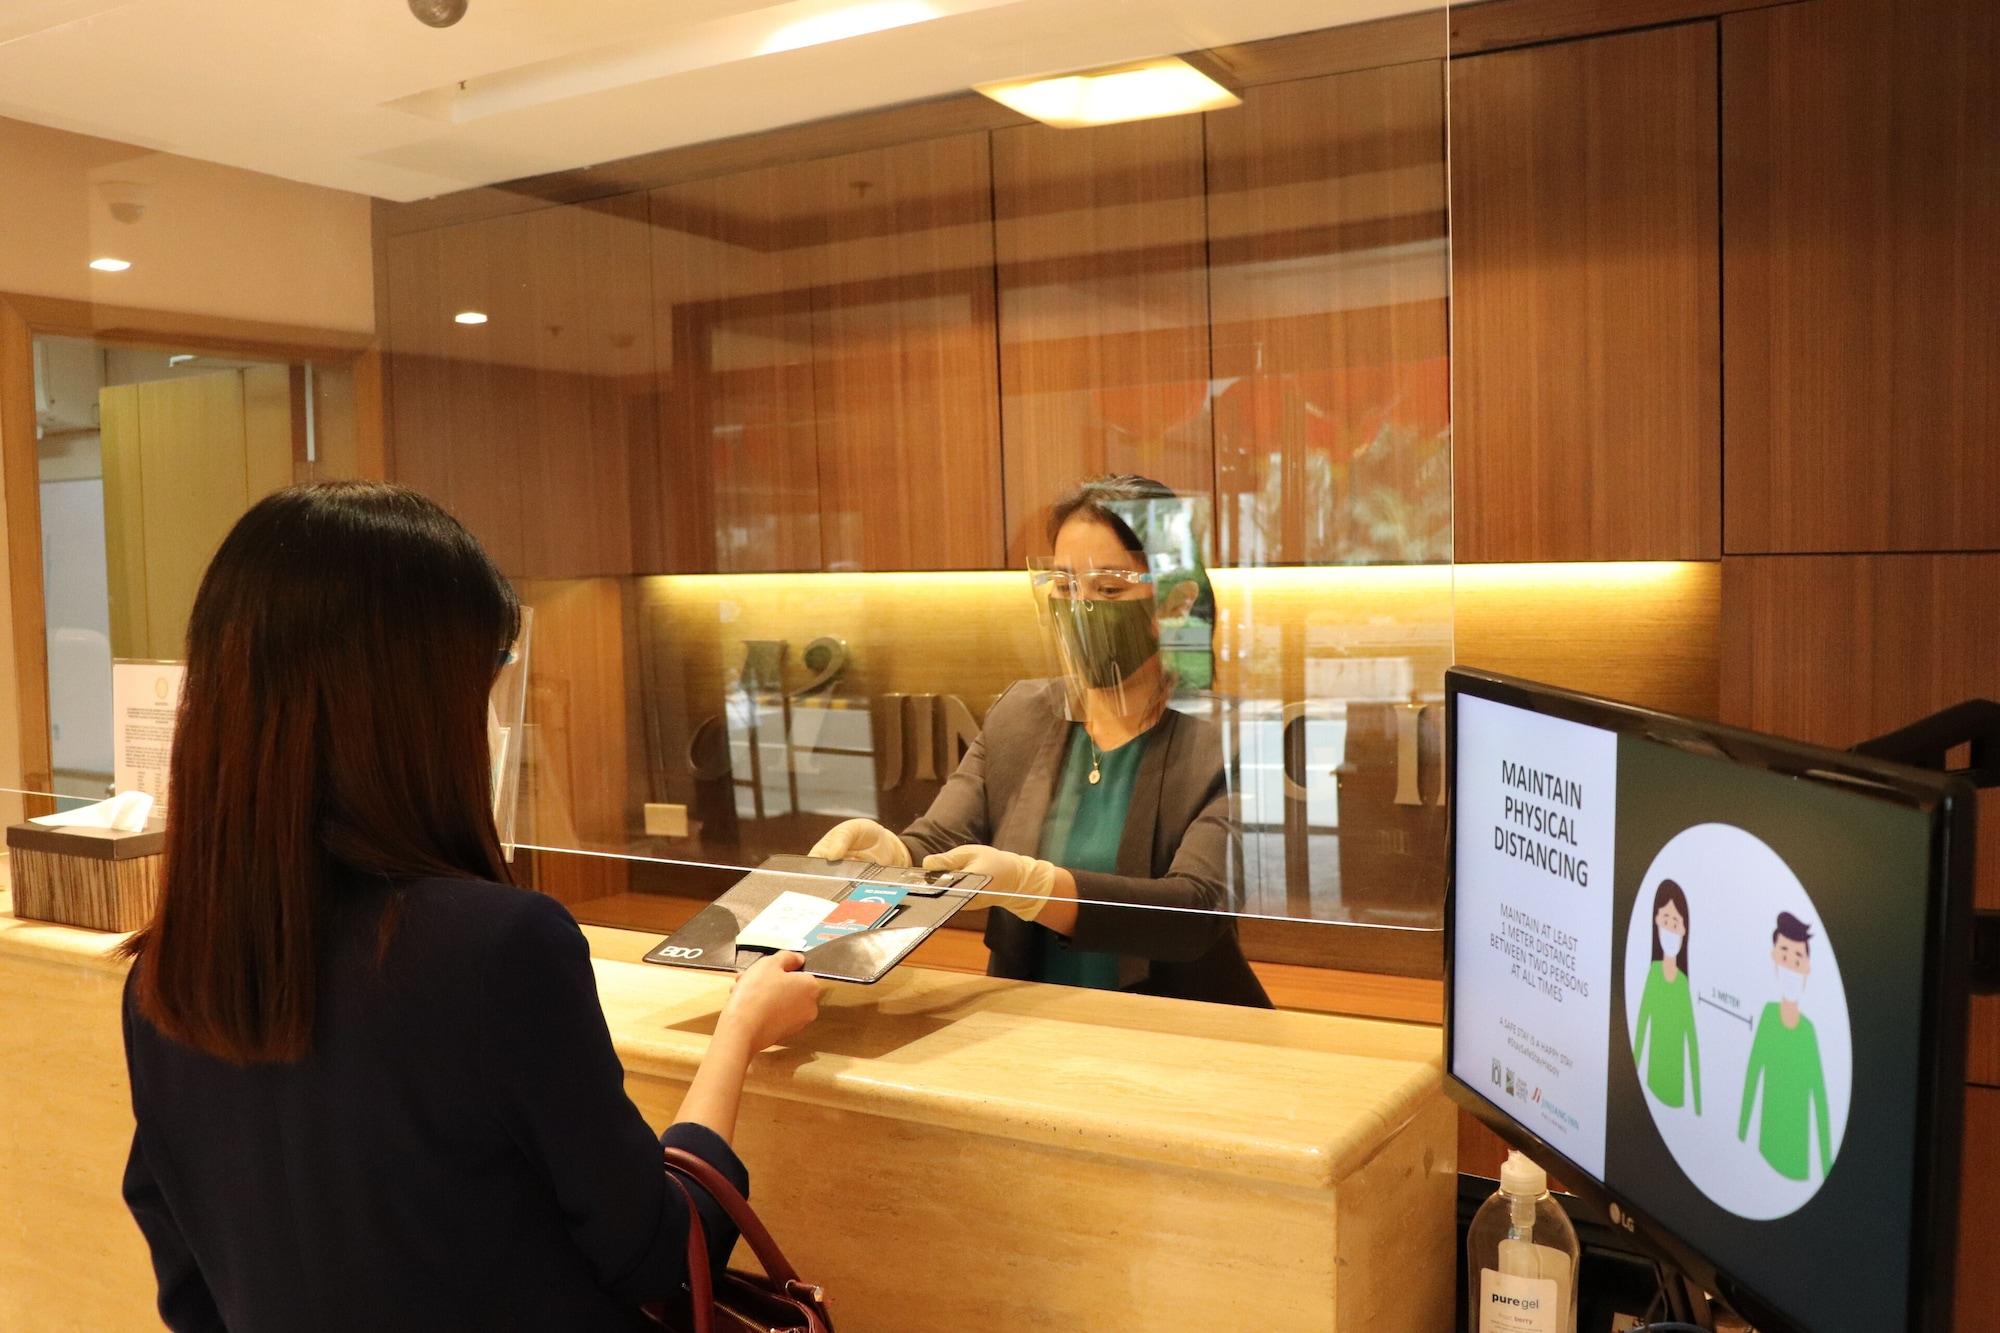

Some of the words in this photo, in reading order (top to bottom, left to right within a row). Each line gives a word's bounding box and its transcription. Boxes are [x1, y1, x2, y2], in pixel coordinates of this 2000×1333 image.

[1501, 759, 1582, 810] MAINTAIN
[1505, 795, 1578, 847] PHYSICAL
[1494, 825, 1588, 887] DISTANCING
[658, 945, 704, 959] BDO
[1500, 902, 1540, 934] MAINTAIN
[1541, 924, 1552, 939] AT
[1553, 928, 1578, 952] LEAST
[1501, 921, 1506, 936] 1
[1508, 924, 1535, 950] METER
[1536, 938, 1576, 972] DISTANCE
[1490, 932, 1527, 964] BETWEEN
[1528, 952, 1548, 975] TWO
[1550, 964, 1589, 998] PERSONS
[1511, 963, 1521, 979] AT
[1522, 969, 1536, 988] ALL
[1537, 976, 1563, 1003] TIMES
[1621, 1212, 1635, 1233] LG
